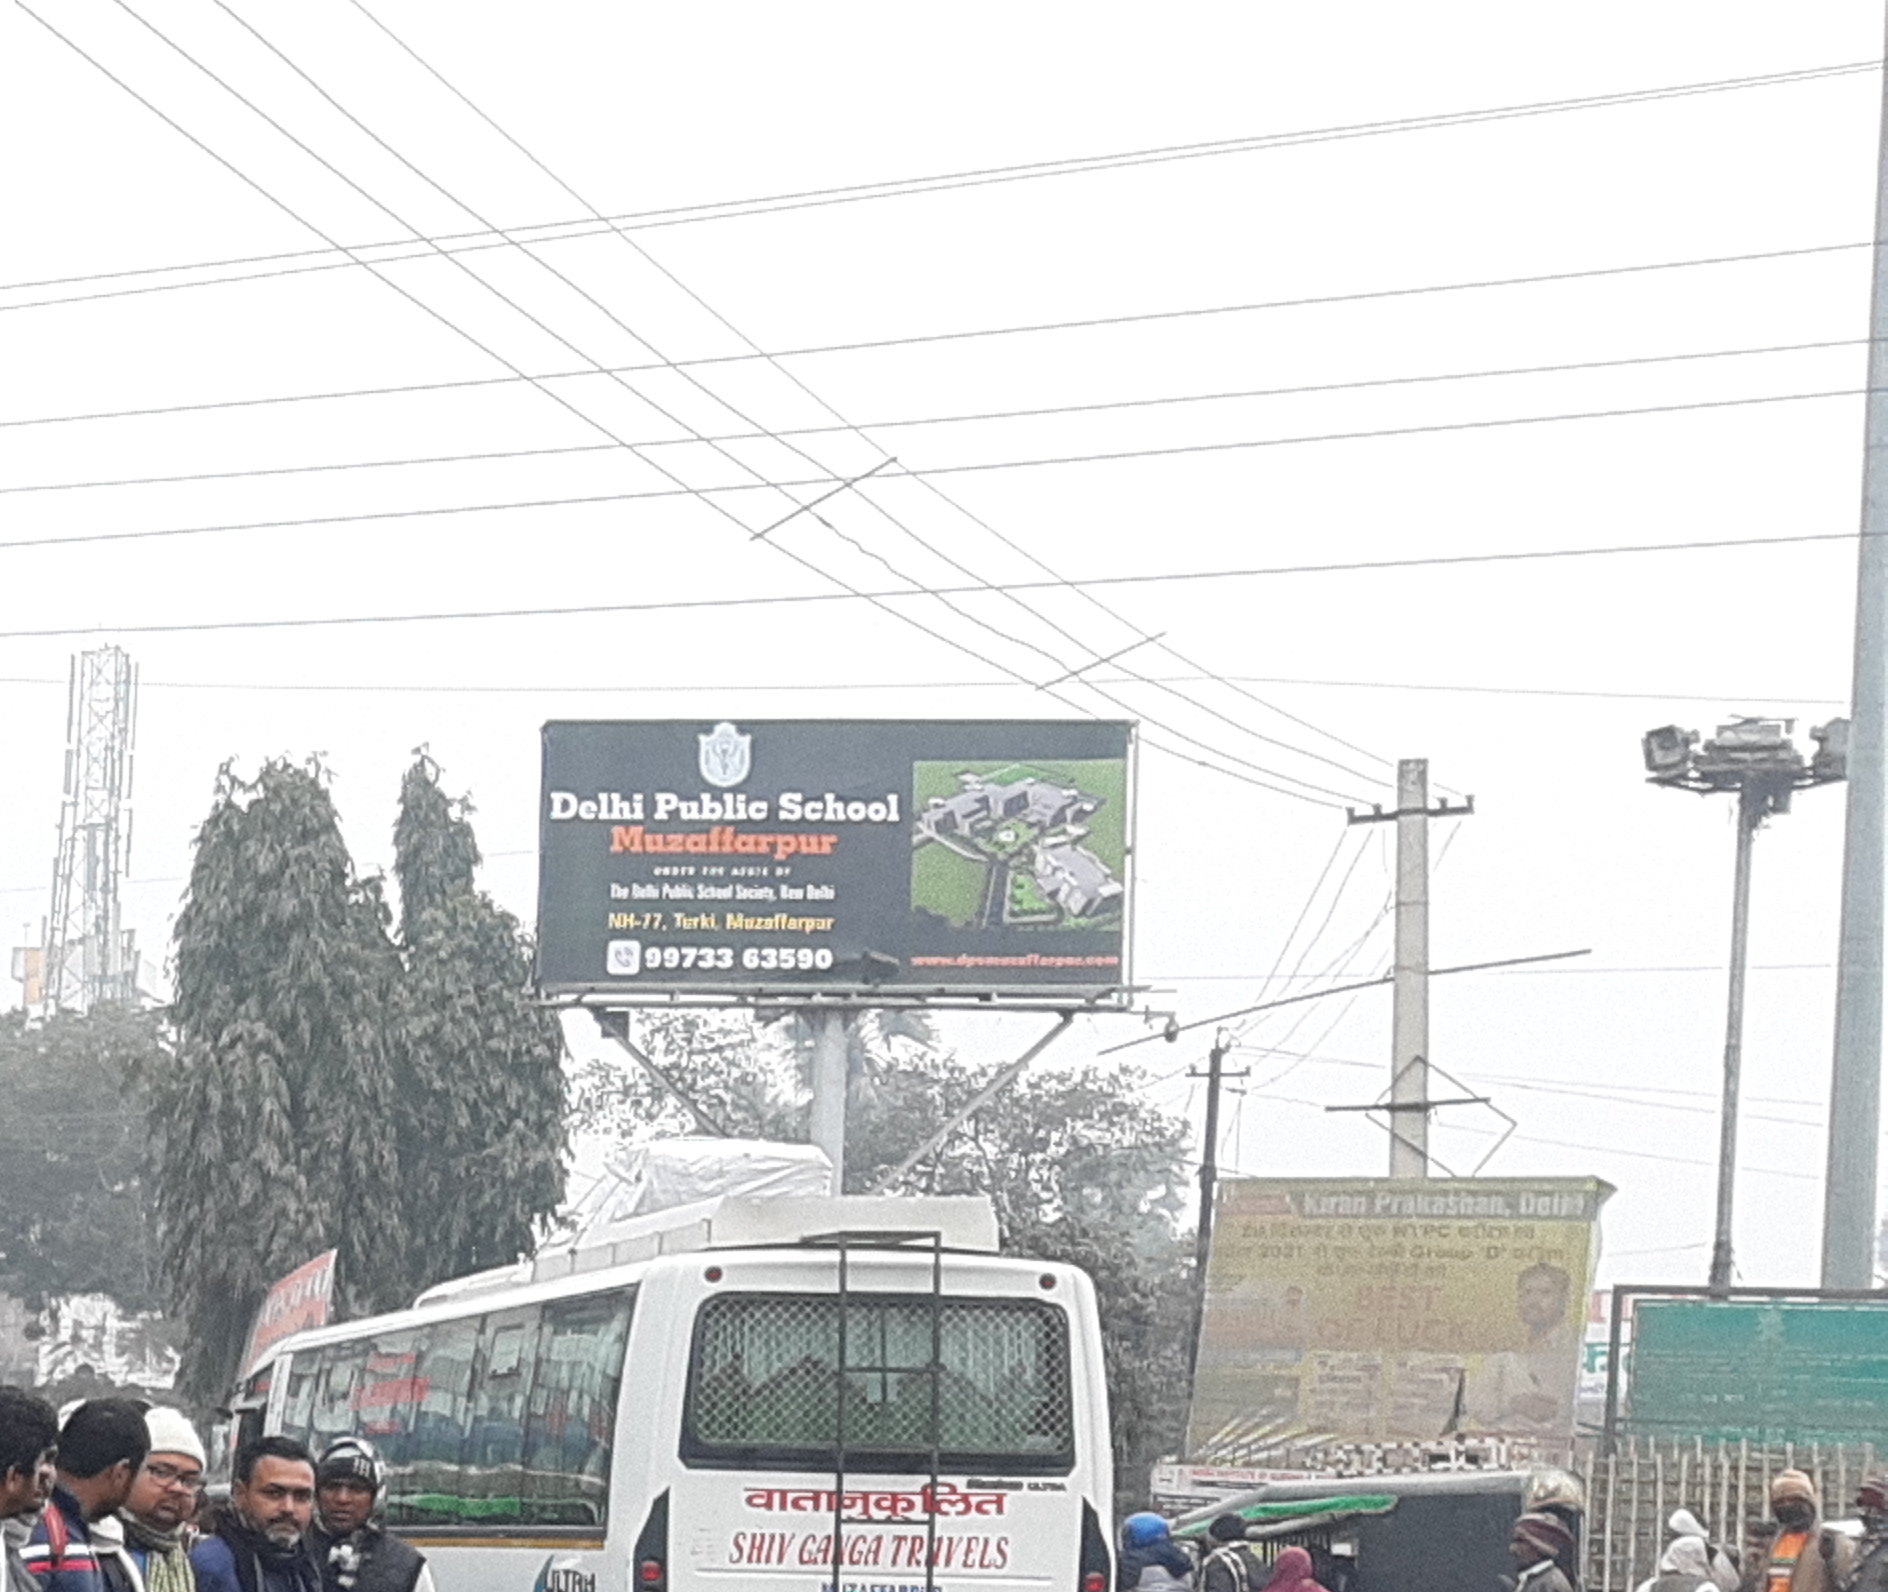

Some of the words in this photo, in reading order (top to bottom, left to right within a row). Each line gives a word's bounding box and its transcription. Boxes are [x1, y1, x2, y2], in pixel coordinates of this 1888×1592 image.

[550, 792, 644, 820] Delhi
[654, 793, 768, 820] Public
[778, 793, 899, 821] School
[610, 826, 839, 859] Muzaffarpur
[662, 884, 694, 899] Public
[697, 884, 733, 900] School
[726, 912, 835, 935] Muzaffarpur
[645, 946, 734, 969] 99733
[742, 947, 834, 970] 63590
[729, 1532, 794, 1566] SHIV
[798, 1533, 884, 1567] GANGA
[891, 1535, 1009, 1570] TRAVELS
